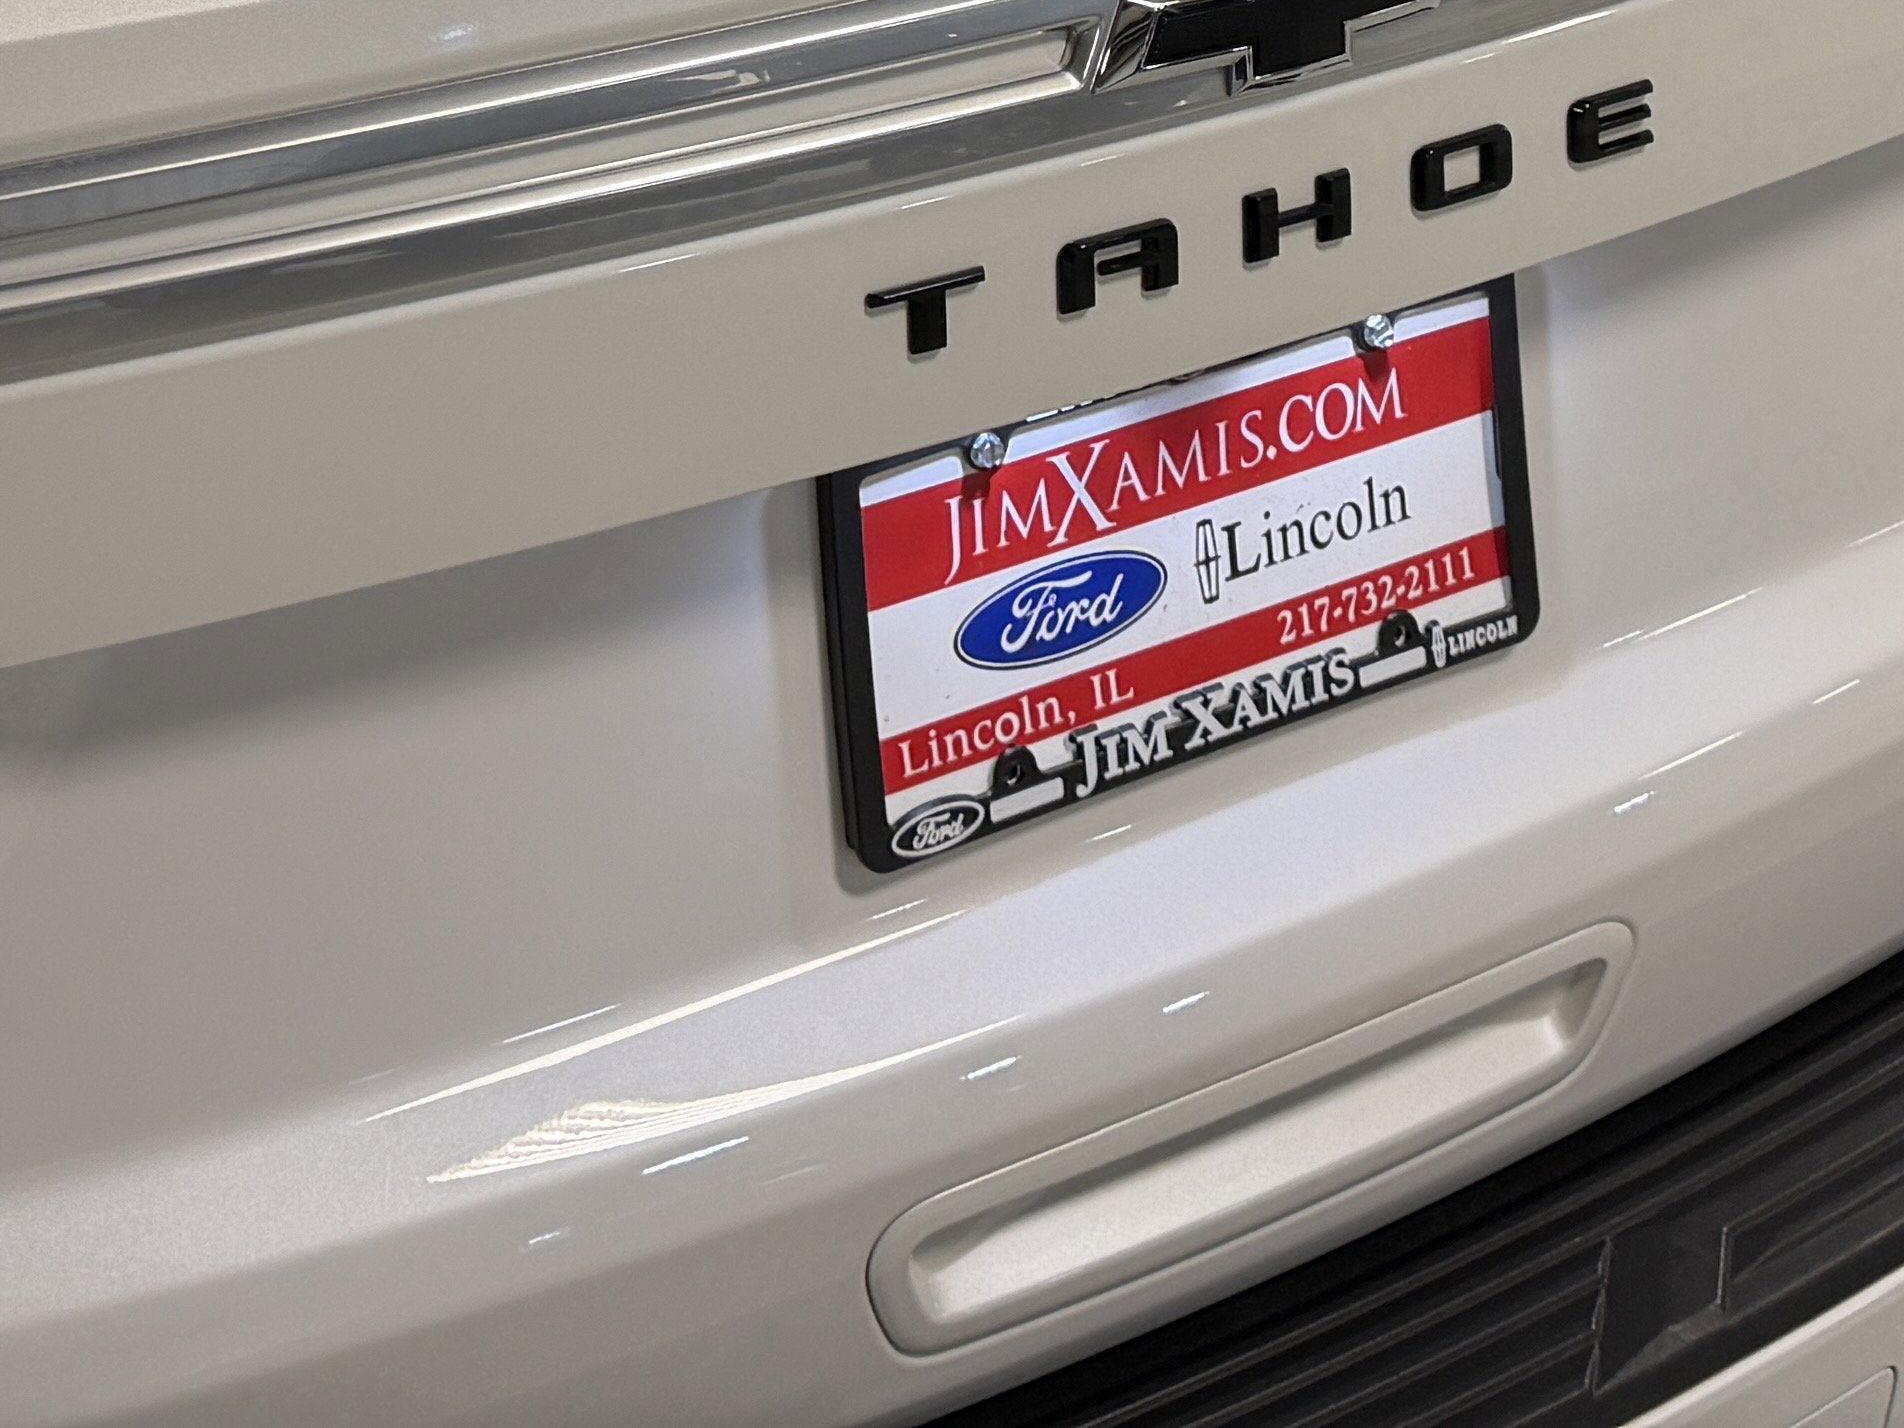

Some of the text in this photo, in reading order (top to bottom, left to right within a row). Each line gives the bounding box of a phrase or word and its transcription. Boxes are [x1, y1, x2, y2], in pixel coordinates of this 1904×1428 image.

[864, 78, 1654, 355] TAHOE
[944, 367, 1408, 584] JIMXAMIS.COM
[1220, 476, 1412, 582] Lincoln
[1000, 569, 1124, 653] Ford
[1277, 546, 1475, 644] 217-732-2111
[1447, 613, 1520, 657] LINCOLN
[898, 669, 1135, 778] Lincoln, IL
[1074, 649, 1355, 798] JIM XAMIS
